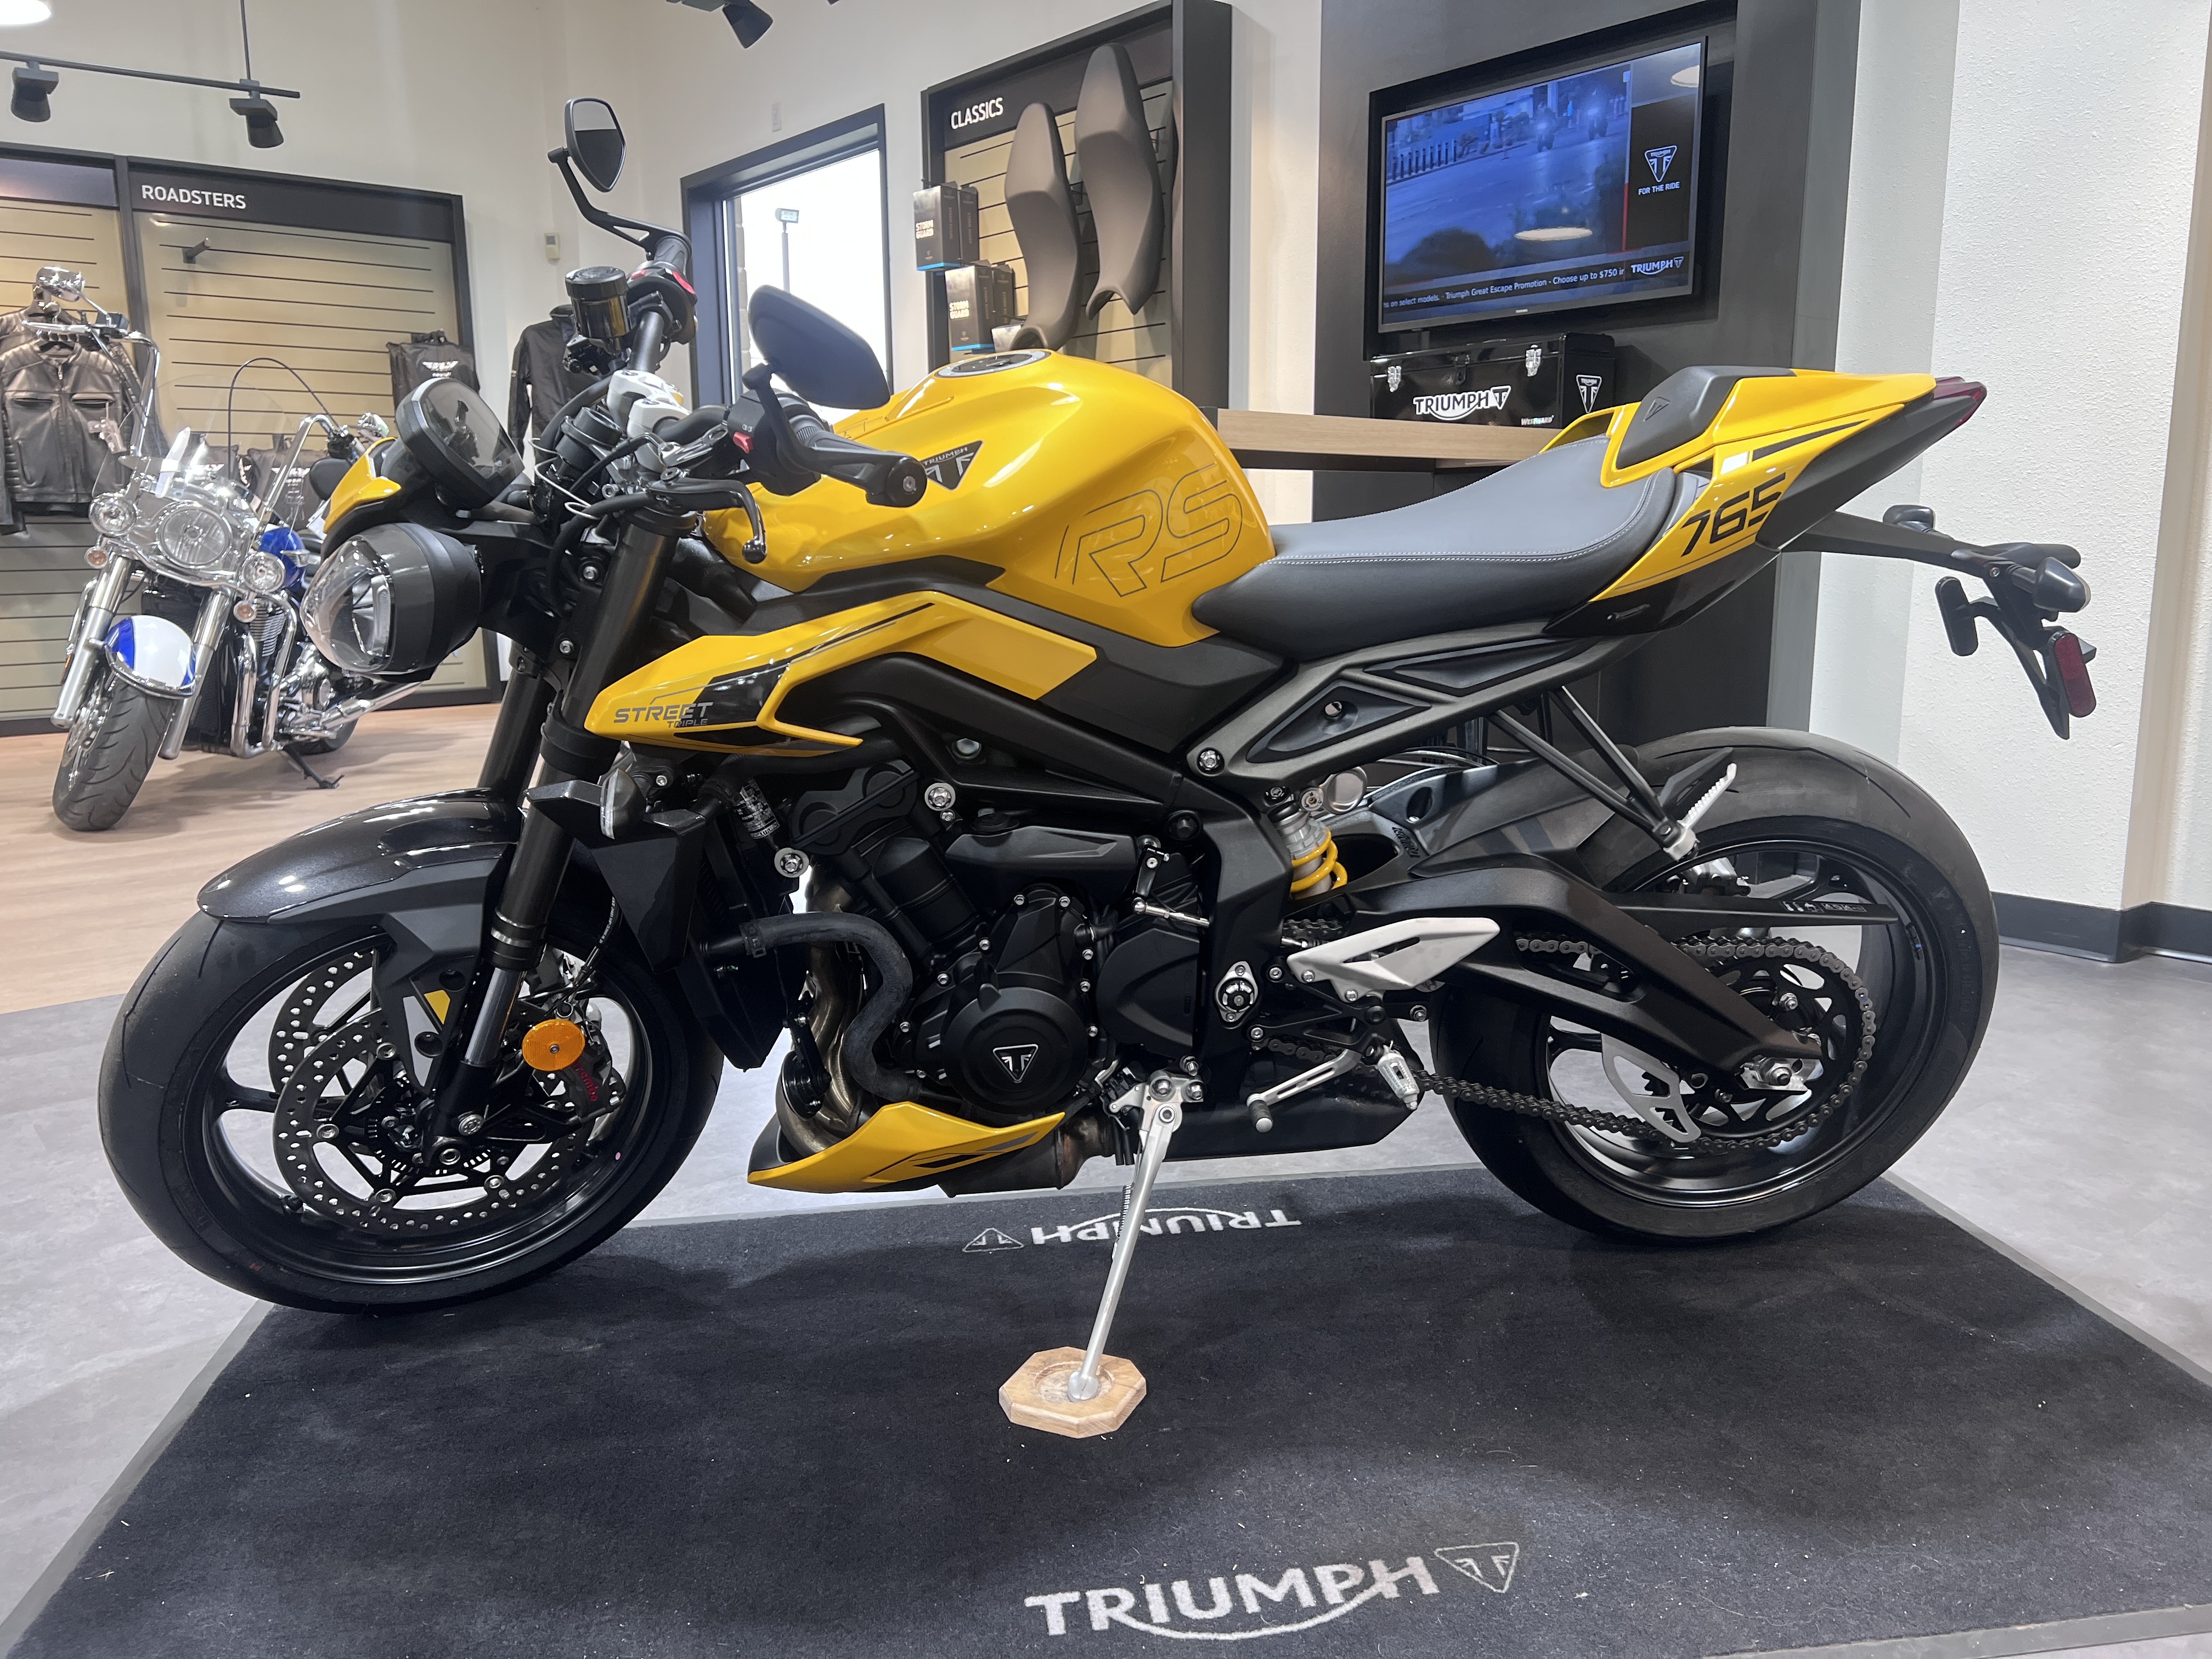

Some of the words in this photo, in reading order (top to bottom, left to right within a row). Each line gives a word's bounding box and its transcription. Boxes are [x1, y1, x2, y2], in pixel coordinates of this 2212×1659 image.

[951, 97, 1004, 129] CLASSICS
[142, 184, 246, 210] ROADSTERS
[1638, 187, 1651, 195] FOR
[1652, 184, 1664, 193] THE
[1665, 182, 1680, 190] RIDE
[916, 219, 934, 232] STORM
[916, 228, 934, 239] GUARD
[1630, 259, 1673, 275] TRIUMPH
[1445, 290, 1470, 300] Triumph
[1471, 287, 1489, 296] Great
[1490, 285, 1513, 293] Escape
[1514, 279, 1547, 290] Promotion
[1553, 275, 1578, 285] Choose
[1579, 274, 1589, 282] up
[1599, 268, 1618, 279] $750
[949, 300, 969, 312] STORM
[950, 308, 970, 319] GUARD
[1414, 391, 1489, 419] TRIUMPH
[922, 446, 968, 466] TRIUMPH
[1680, 472, 1786, 558] 765
[1054, 462, 1243, 598] RS
[613, 702, 714, 724] STREET
[667, 718, 708, 728] TRIPLE
[1024, 1556, 1440, 1641] TRIUMPH
